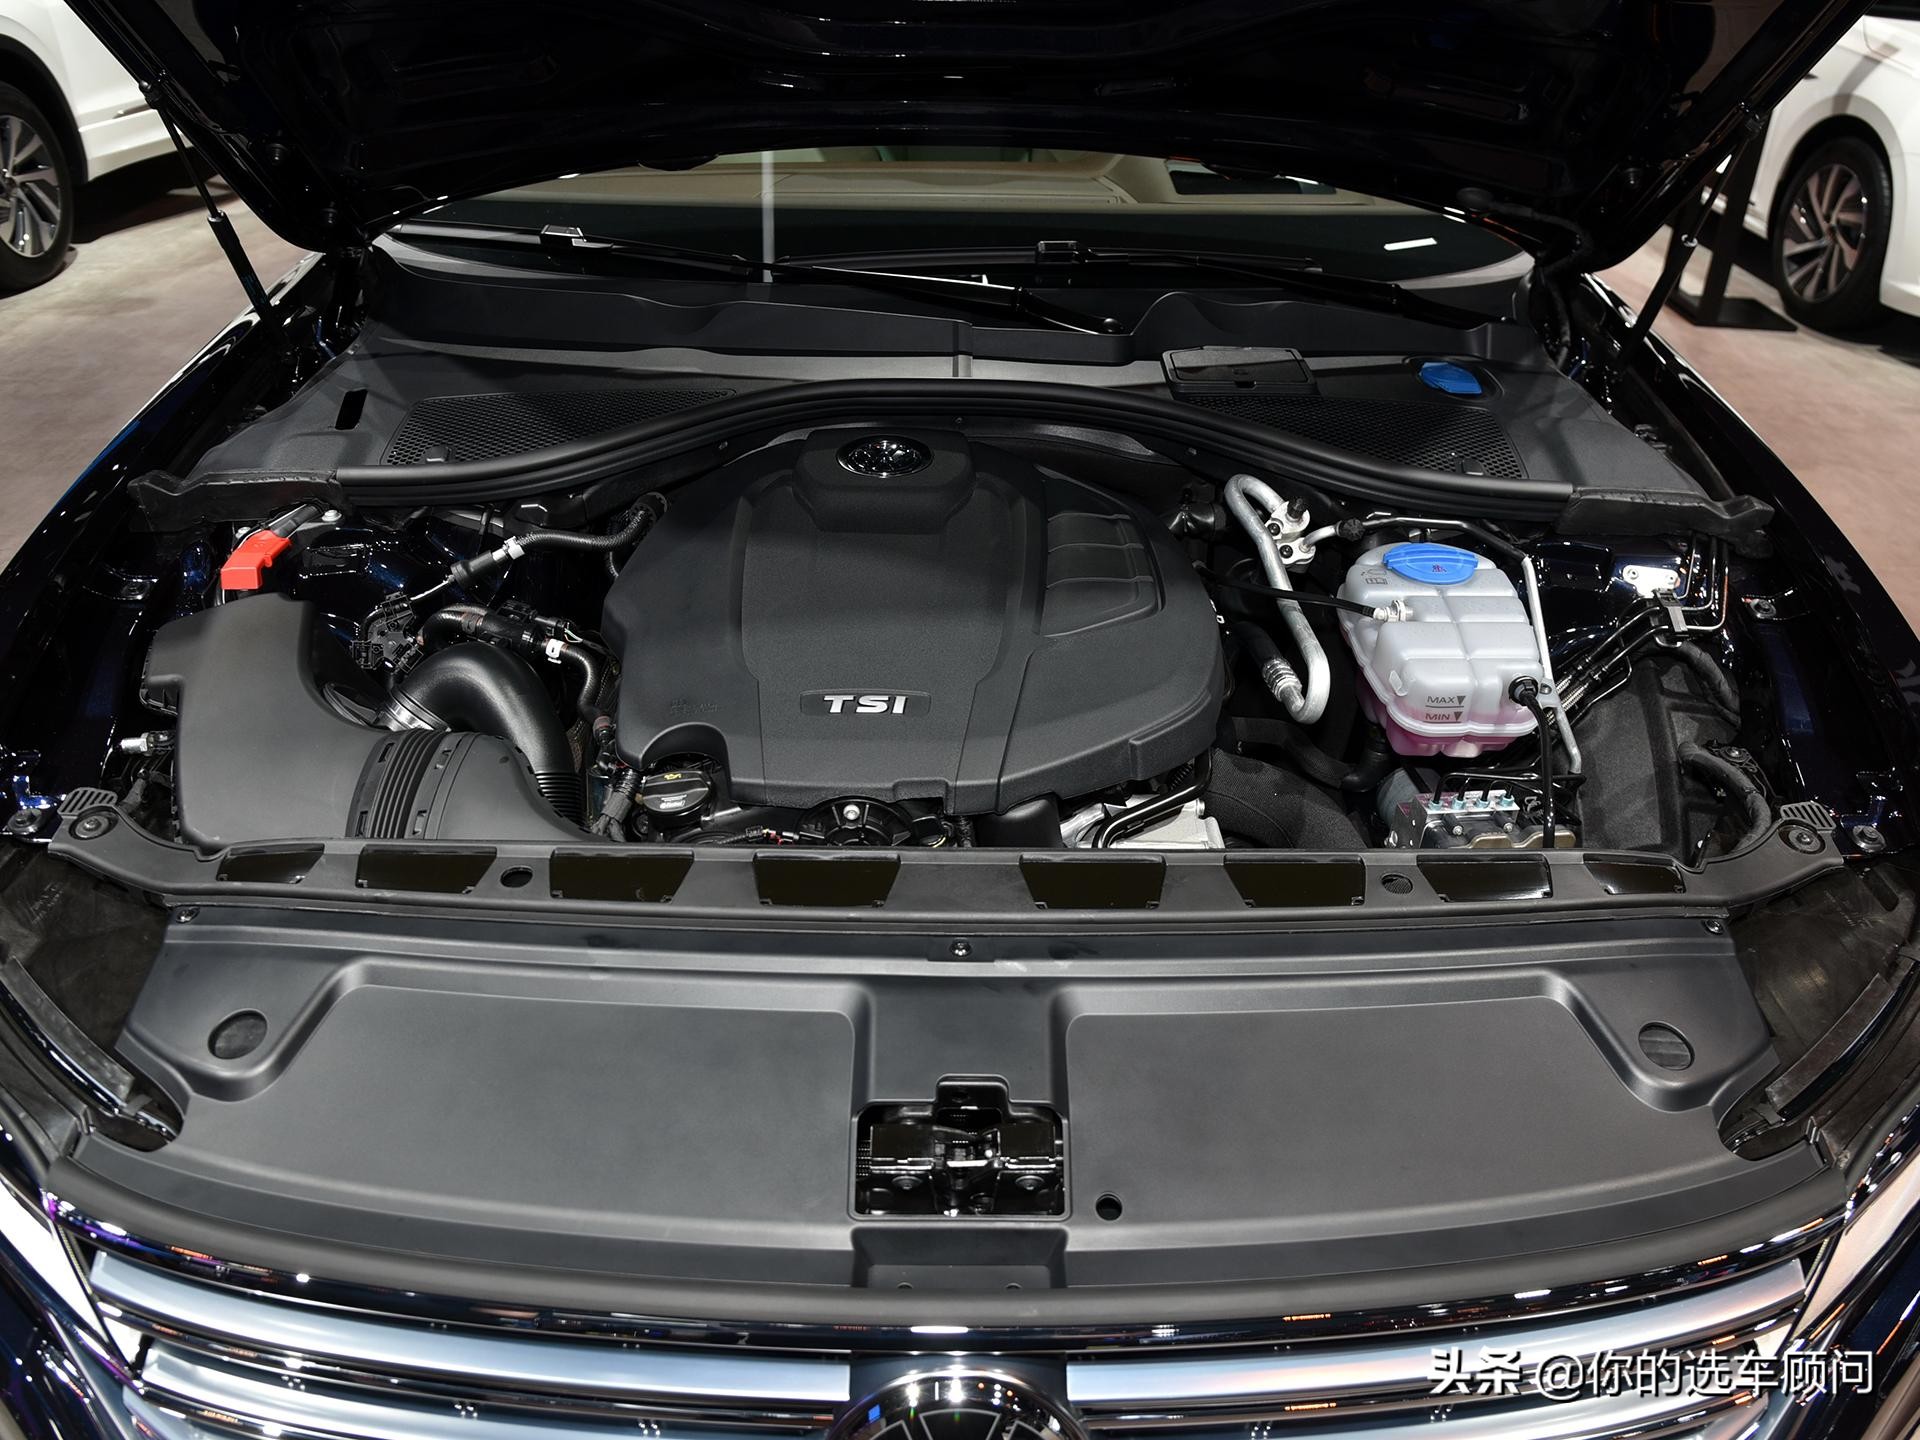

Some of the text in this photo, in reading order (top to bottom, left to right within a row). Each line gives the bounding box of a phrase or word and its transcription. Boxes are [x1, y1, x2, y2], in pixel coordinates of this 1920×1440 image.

[823, 694, 907, 714] TSI
[1427, 696, 1456, 704] MAX
[1425, 712, 1450, 721] MIN
